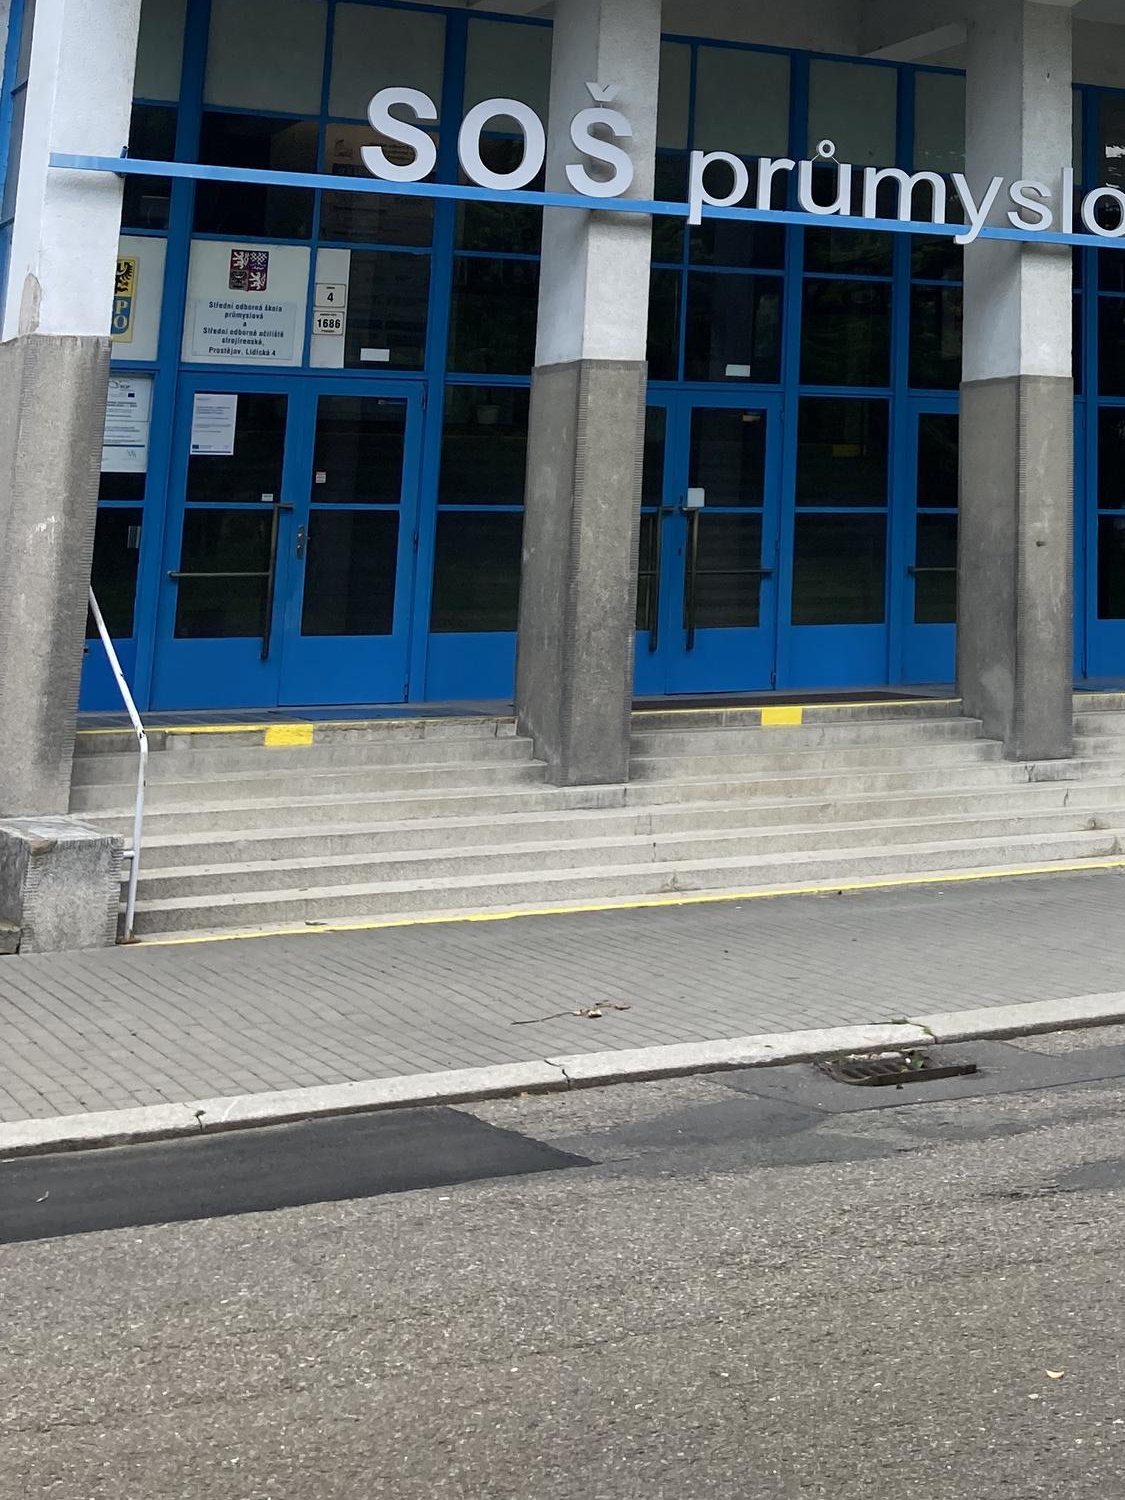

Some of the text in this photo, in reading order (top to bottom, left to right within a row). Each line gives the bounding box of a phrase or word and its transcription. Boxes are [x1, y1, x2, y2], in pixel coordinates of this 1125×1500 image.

[360, 82, 634, 198] SOŠ
[327, 292, 334, 302] 4
[208, 301, 283, 312] Střední odborná škola
[224, 311, 264, 320] průmyslová
[317, 319, 341, 329] 1686
[202, 327, 284, 338] Střední odborné učiliště
[245, 348, 270, 356] Lidická
